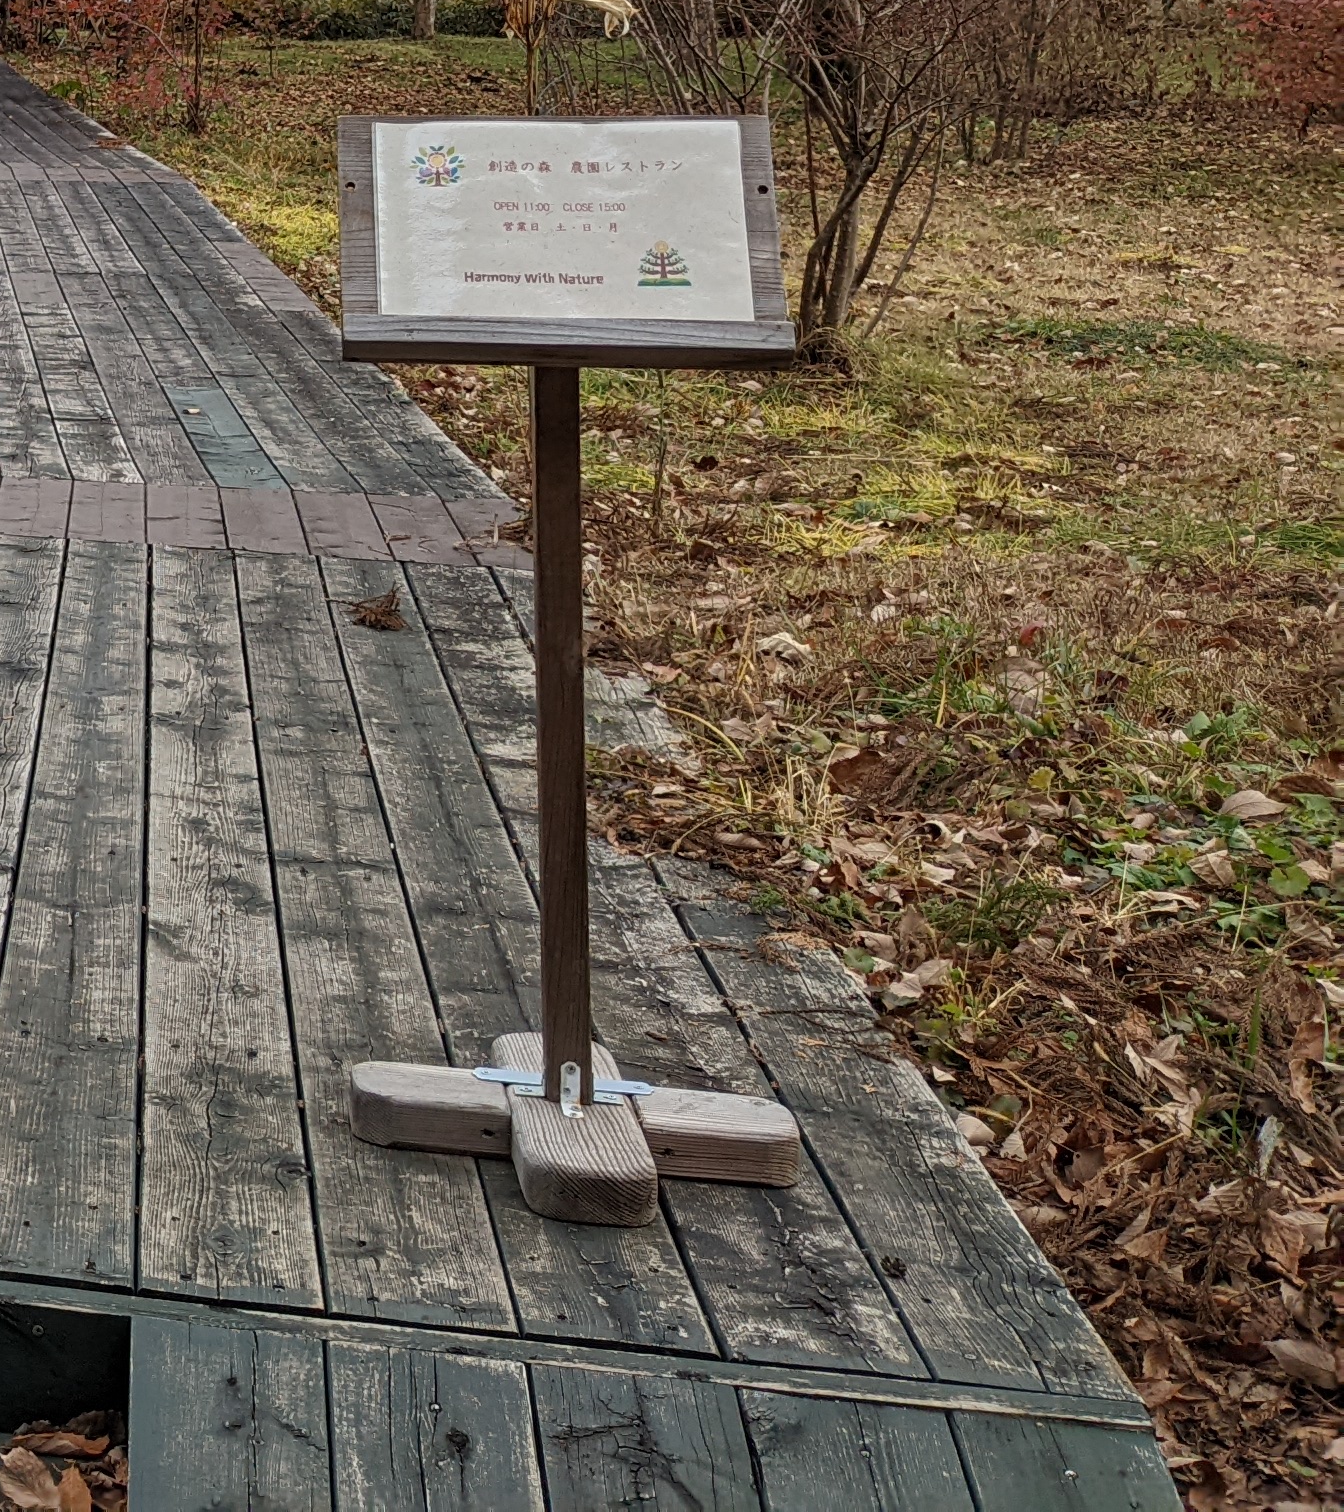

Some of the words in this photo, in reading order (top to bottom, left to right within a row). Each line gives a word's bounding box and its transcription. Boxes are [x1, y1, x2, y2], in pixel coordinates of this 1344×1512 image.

[488, 160, 552, 174] 創造の森
[570, 160, 683, 174] 農園レストラン
[493, 201, 519, 212] OPEN
[523, 201, 551, 212] 11:00
[562, 201, 594, 213] CLOSE
[598, 202, 626, 213] 15:00
[502, 221, 539, 232] 営業日
[464, 271, 521, 285] Harmony
[524, 272, 555, 284] With
[558, 272, 604, 285] Nature
